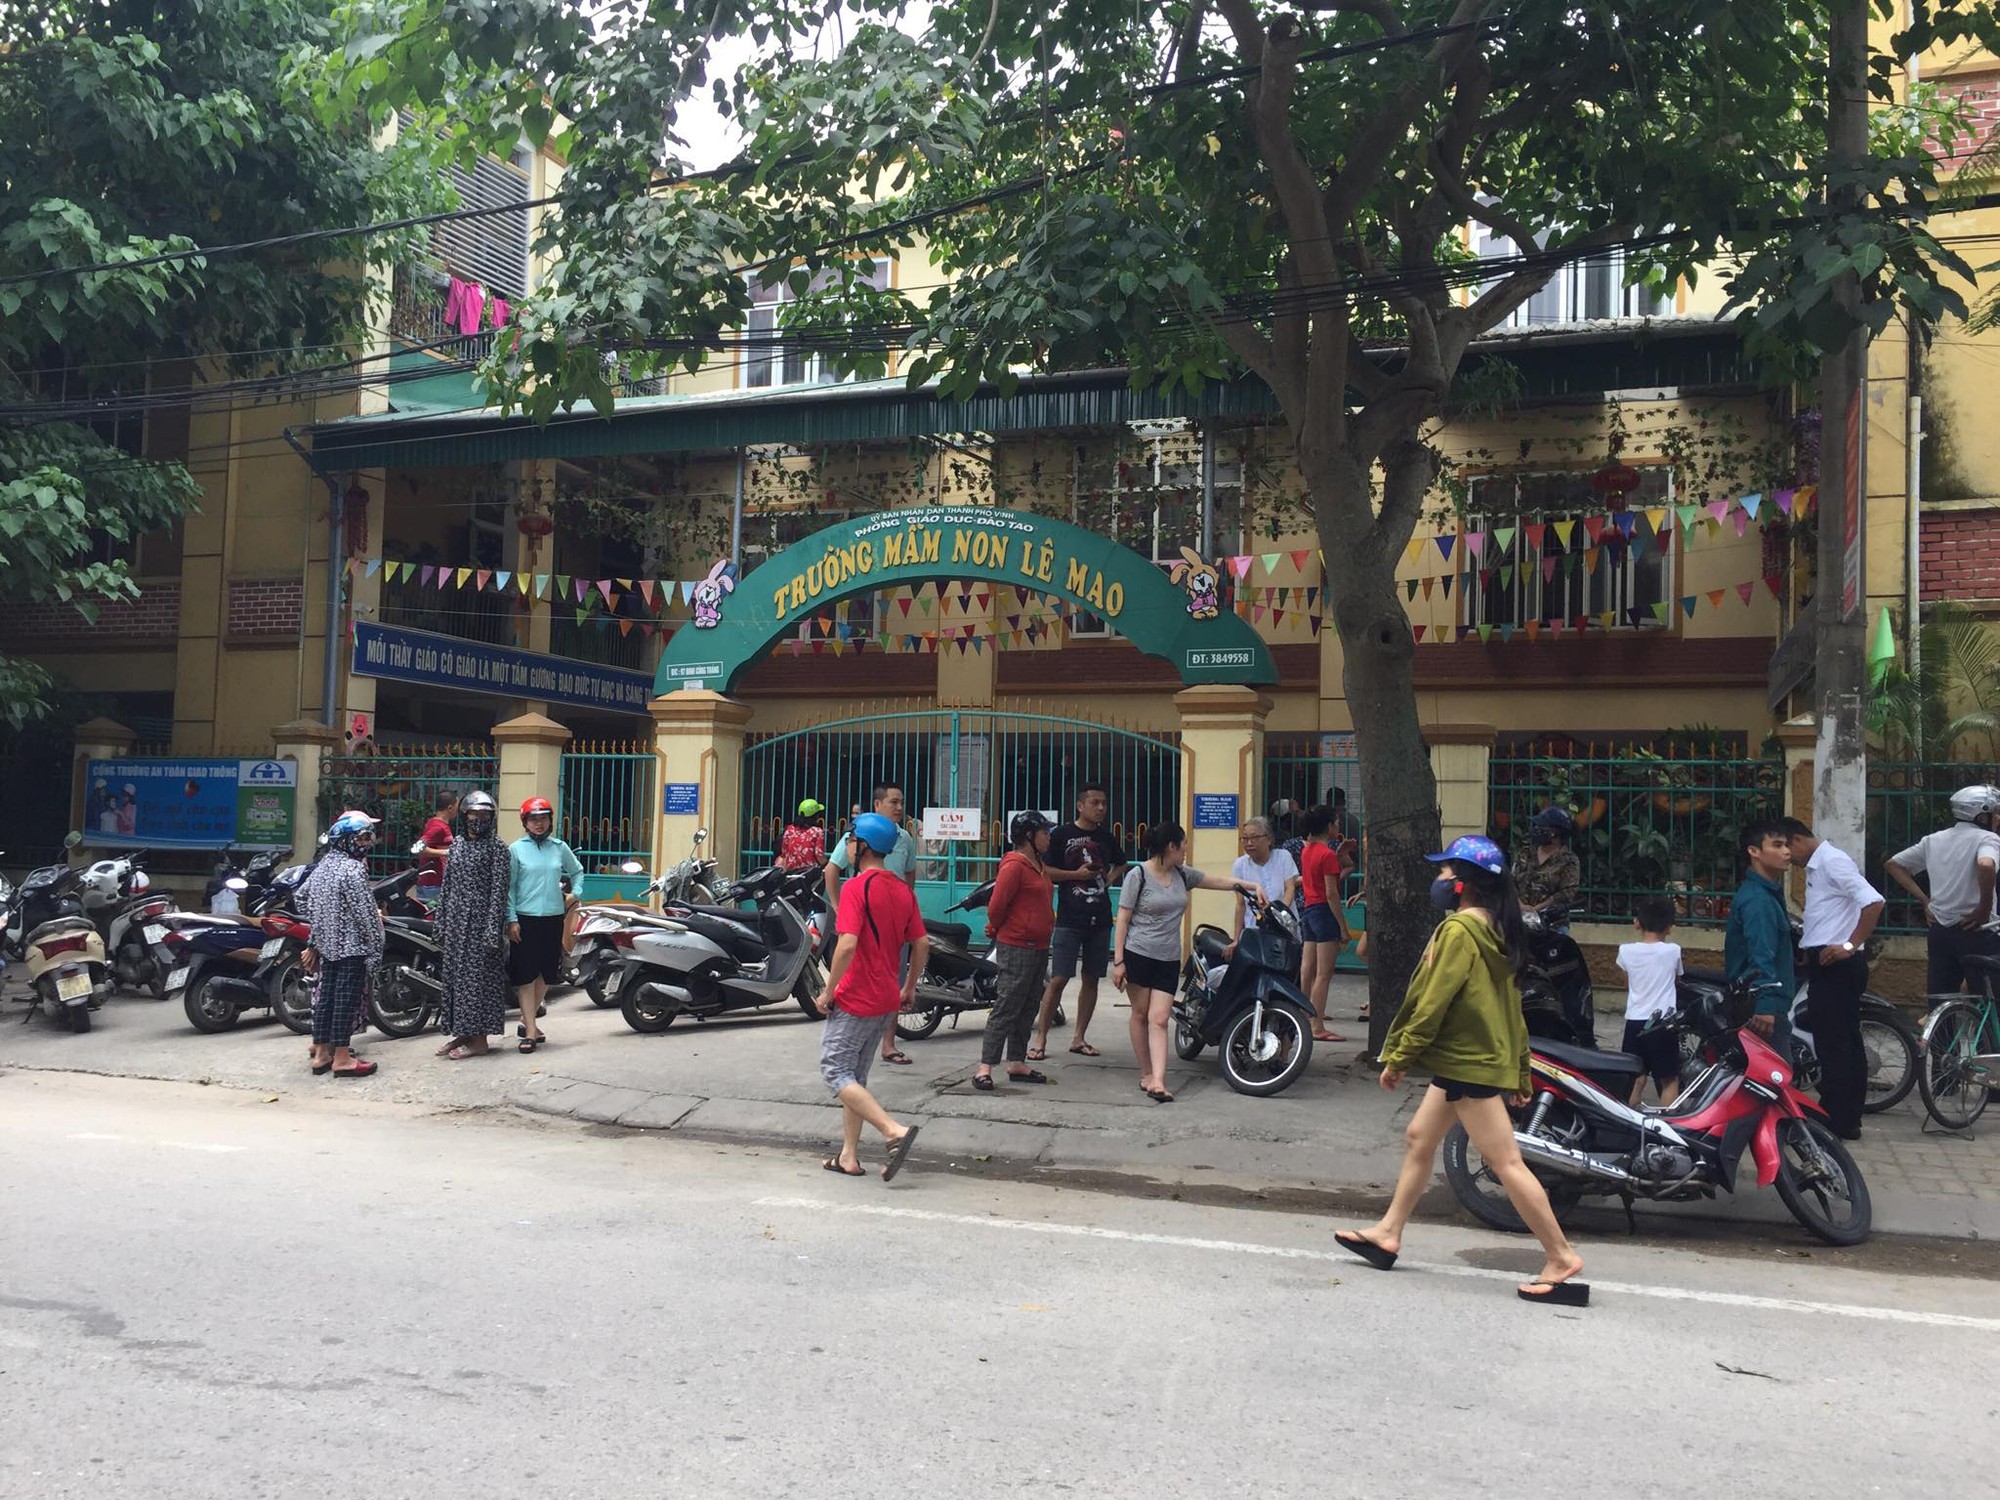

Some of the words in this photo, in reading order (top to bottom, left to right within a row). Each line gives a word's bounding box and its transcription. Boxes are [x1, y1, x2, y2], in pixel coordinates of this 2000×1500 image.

[906, 513, 940, 524] GIÁO
[773, 542, 874, 620] TRƯỜNG
[882, 526, 942, 568] MẦM
[952, 530, 1010, 569] NON
[1021, 538, 1055, 583] LÊ
[1066, 557, 1125, 617] MAO
[390, 638, 413, 669] THẦY
[416, 645, 437, 673] GIÁO
[441, 649, 453, 674] CÔ
[456, 652, 476, 678] GIÁO
[492, 658, 510, 686] MỘT
[1192, 653, 1209, 664] ĐT:
[1210, 653, 1249, 664] 3849558
[151, 767, 162, 777] AN
[188, 767, 207, 778] GIAO
